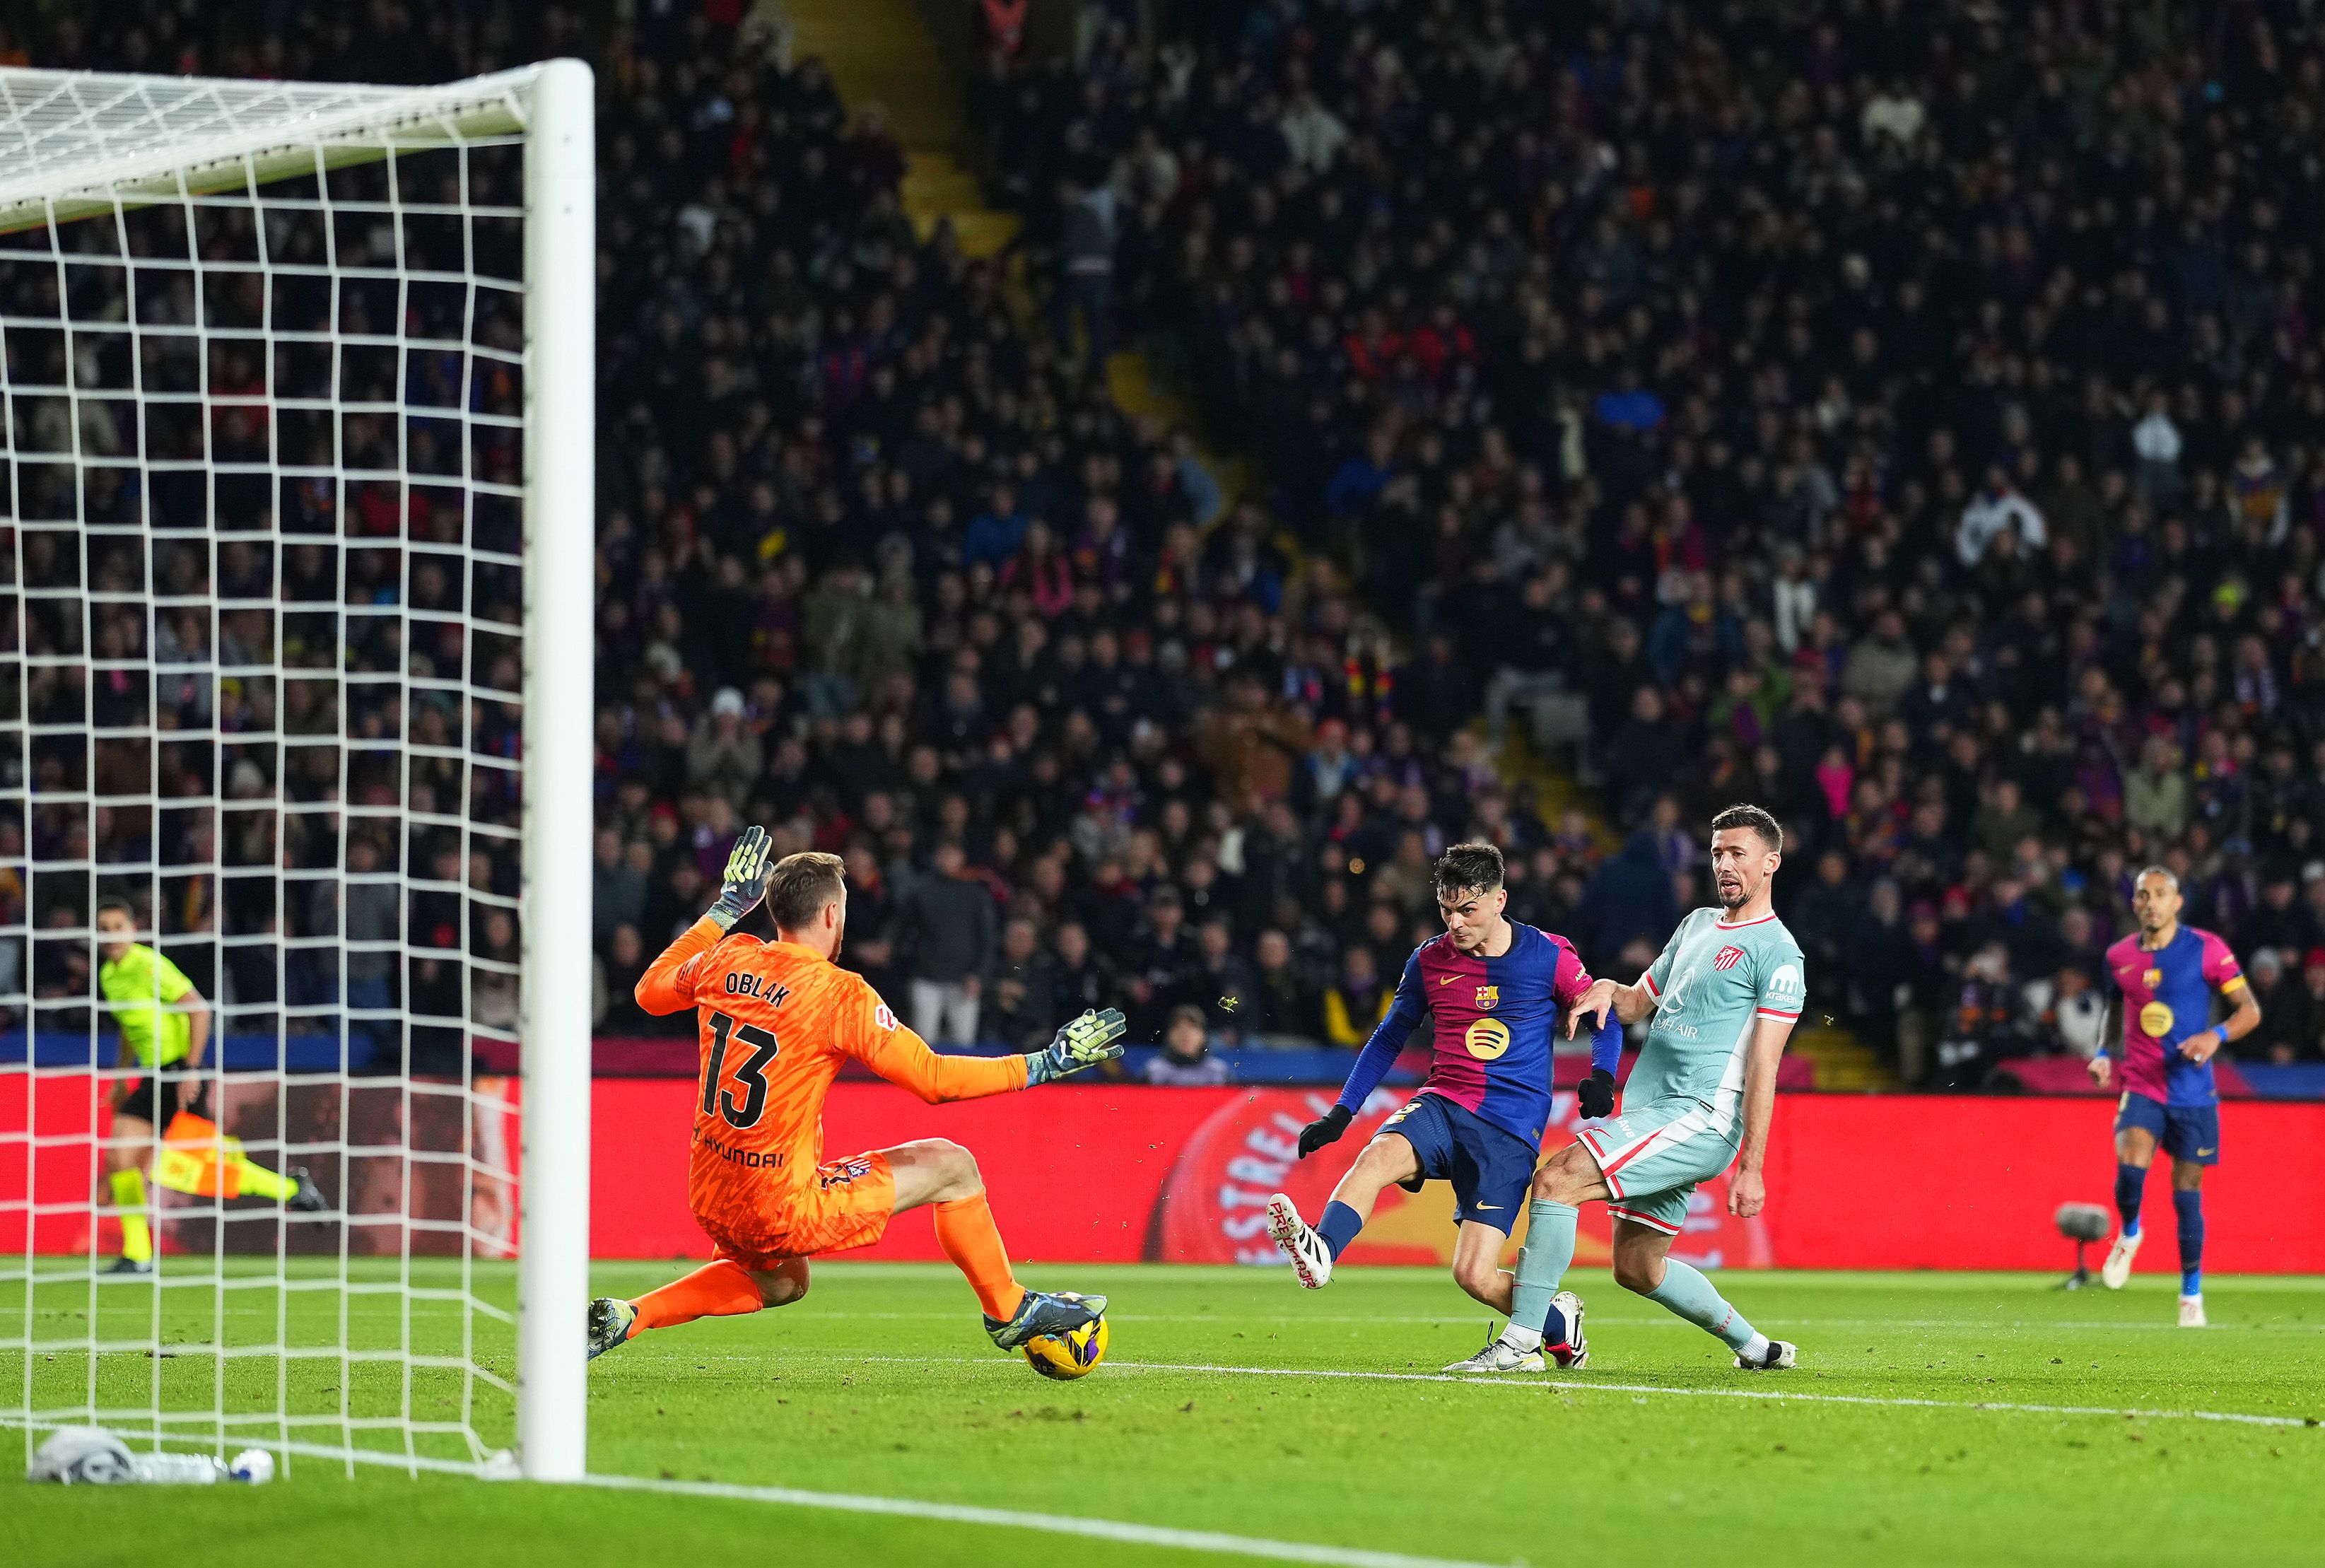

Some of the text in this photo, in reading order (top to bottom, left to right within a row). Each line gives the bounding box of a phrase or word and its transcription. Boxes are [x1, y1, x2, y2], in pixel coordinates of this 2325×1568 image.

[725, 972, 790, 1008] OBLAK
[1765, 990, 1798, 1005] kraken
[1673, 1023, 1698, 1040] AIR
[703, 1010, 779, 1130] 13
[704, 1133, 784, 1169] HYUNDAI
